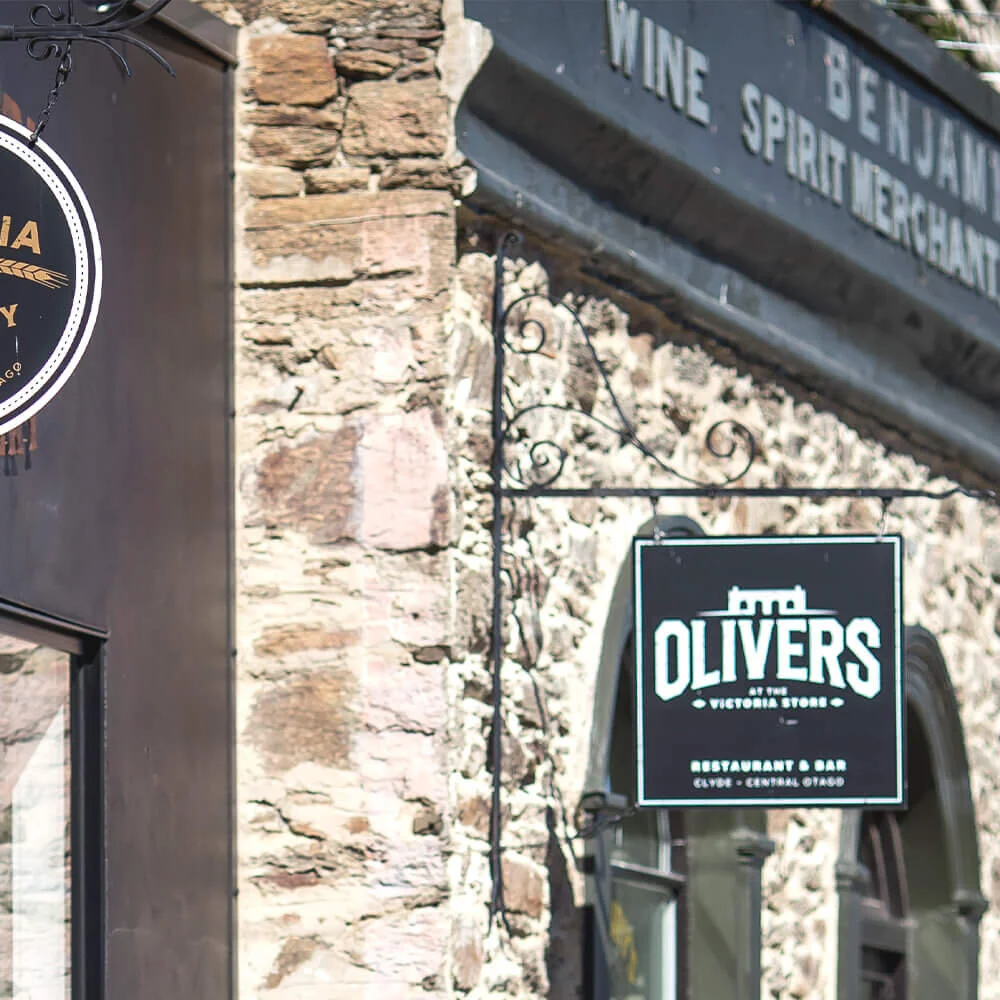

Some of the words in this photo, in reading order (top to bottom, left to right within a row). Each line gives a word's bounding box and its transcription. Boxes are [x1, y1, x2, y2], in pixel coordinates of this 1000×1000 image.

[606, 0, 710, 124] WINE
[741, 82, 847, 204] SPIRIT
[654, 617, 881, 701] OLIVERS
[748, 686, 763, 696] AT
[766, 686, 788, 696] THE
[709, 698, 778, 709] VICTORIA
[781, 697, 828, 708] STORE
[690, 759, 794, 773] RESTAURANT
[798, 759, 810, 772] &
[814, 759, 847, 772] BAR
[693, 777, 733, 788] CLYDE
[745, 777, 800, 788] CENTRAL
[802, 776, 845, 788] OTAGO
